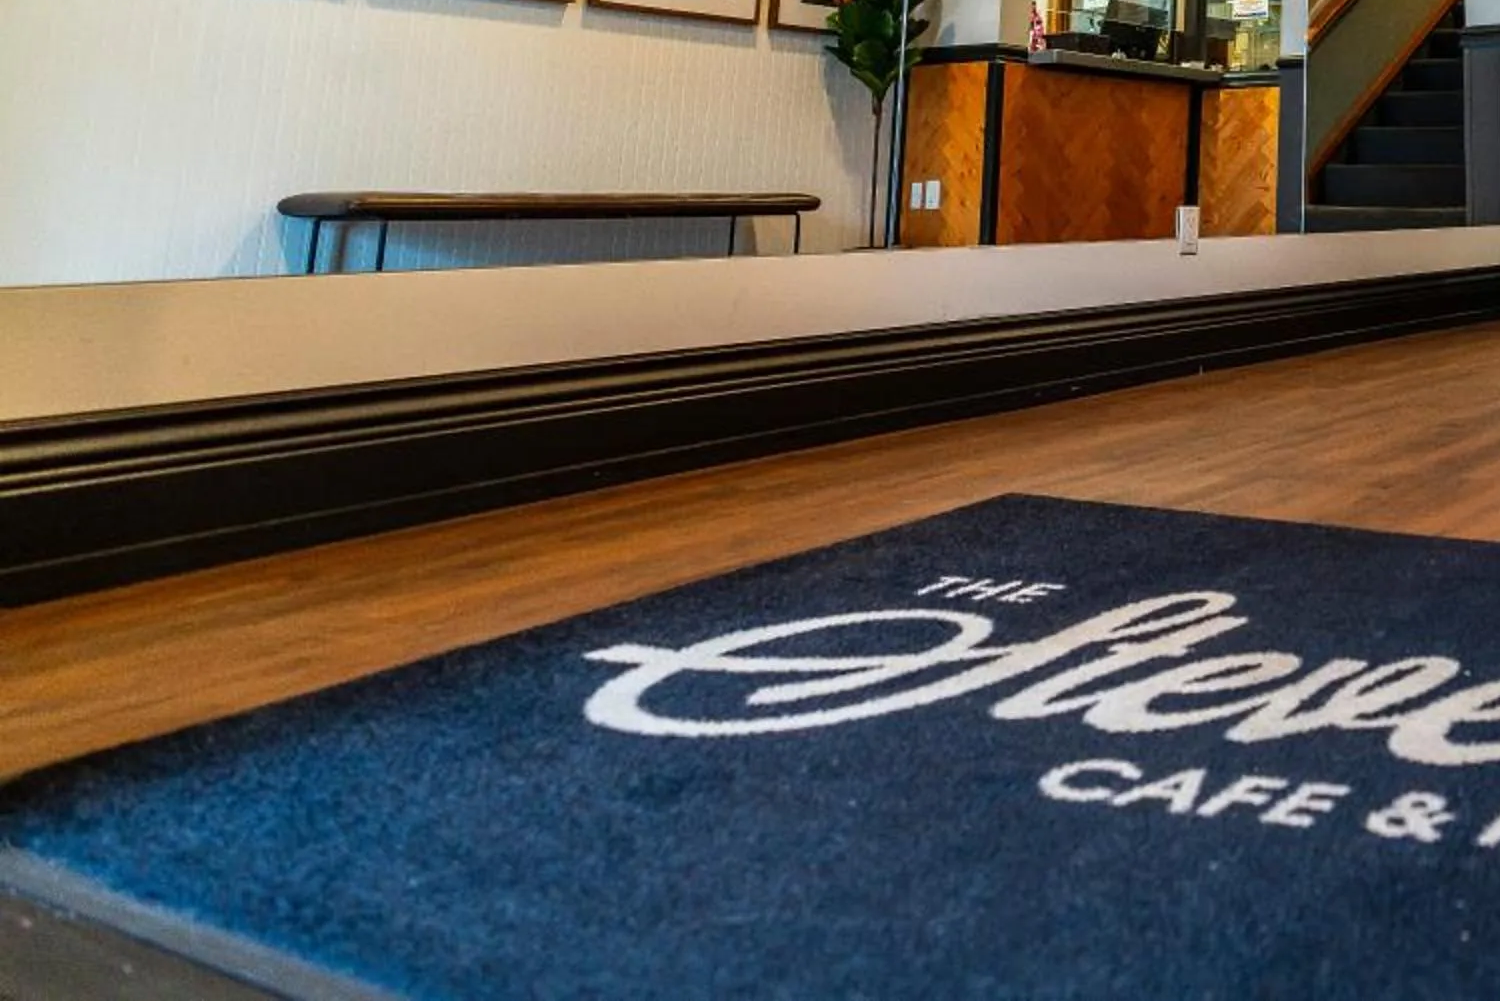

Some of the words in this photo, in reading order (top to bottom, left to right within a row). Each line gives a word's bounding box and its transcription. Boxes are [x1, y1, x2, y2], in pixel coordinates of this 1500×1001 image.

[917, 575, 1065, 603] THE
[1038, 759, 1350, 827] CAFE
[1366, 792, 1456, 843] &
